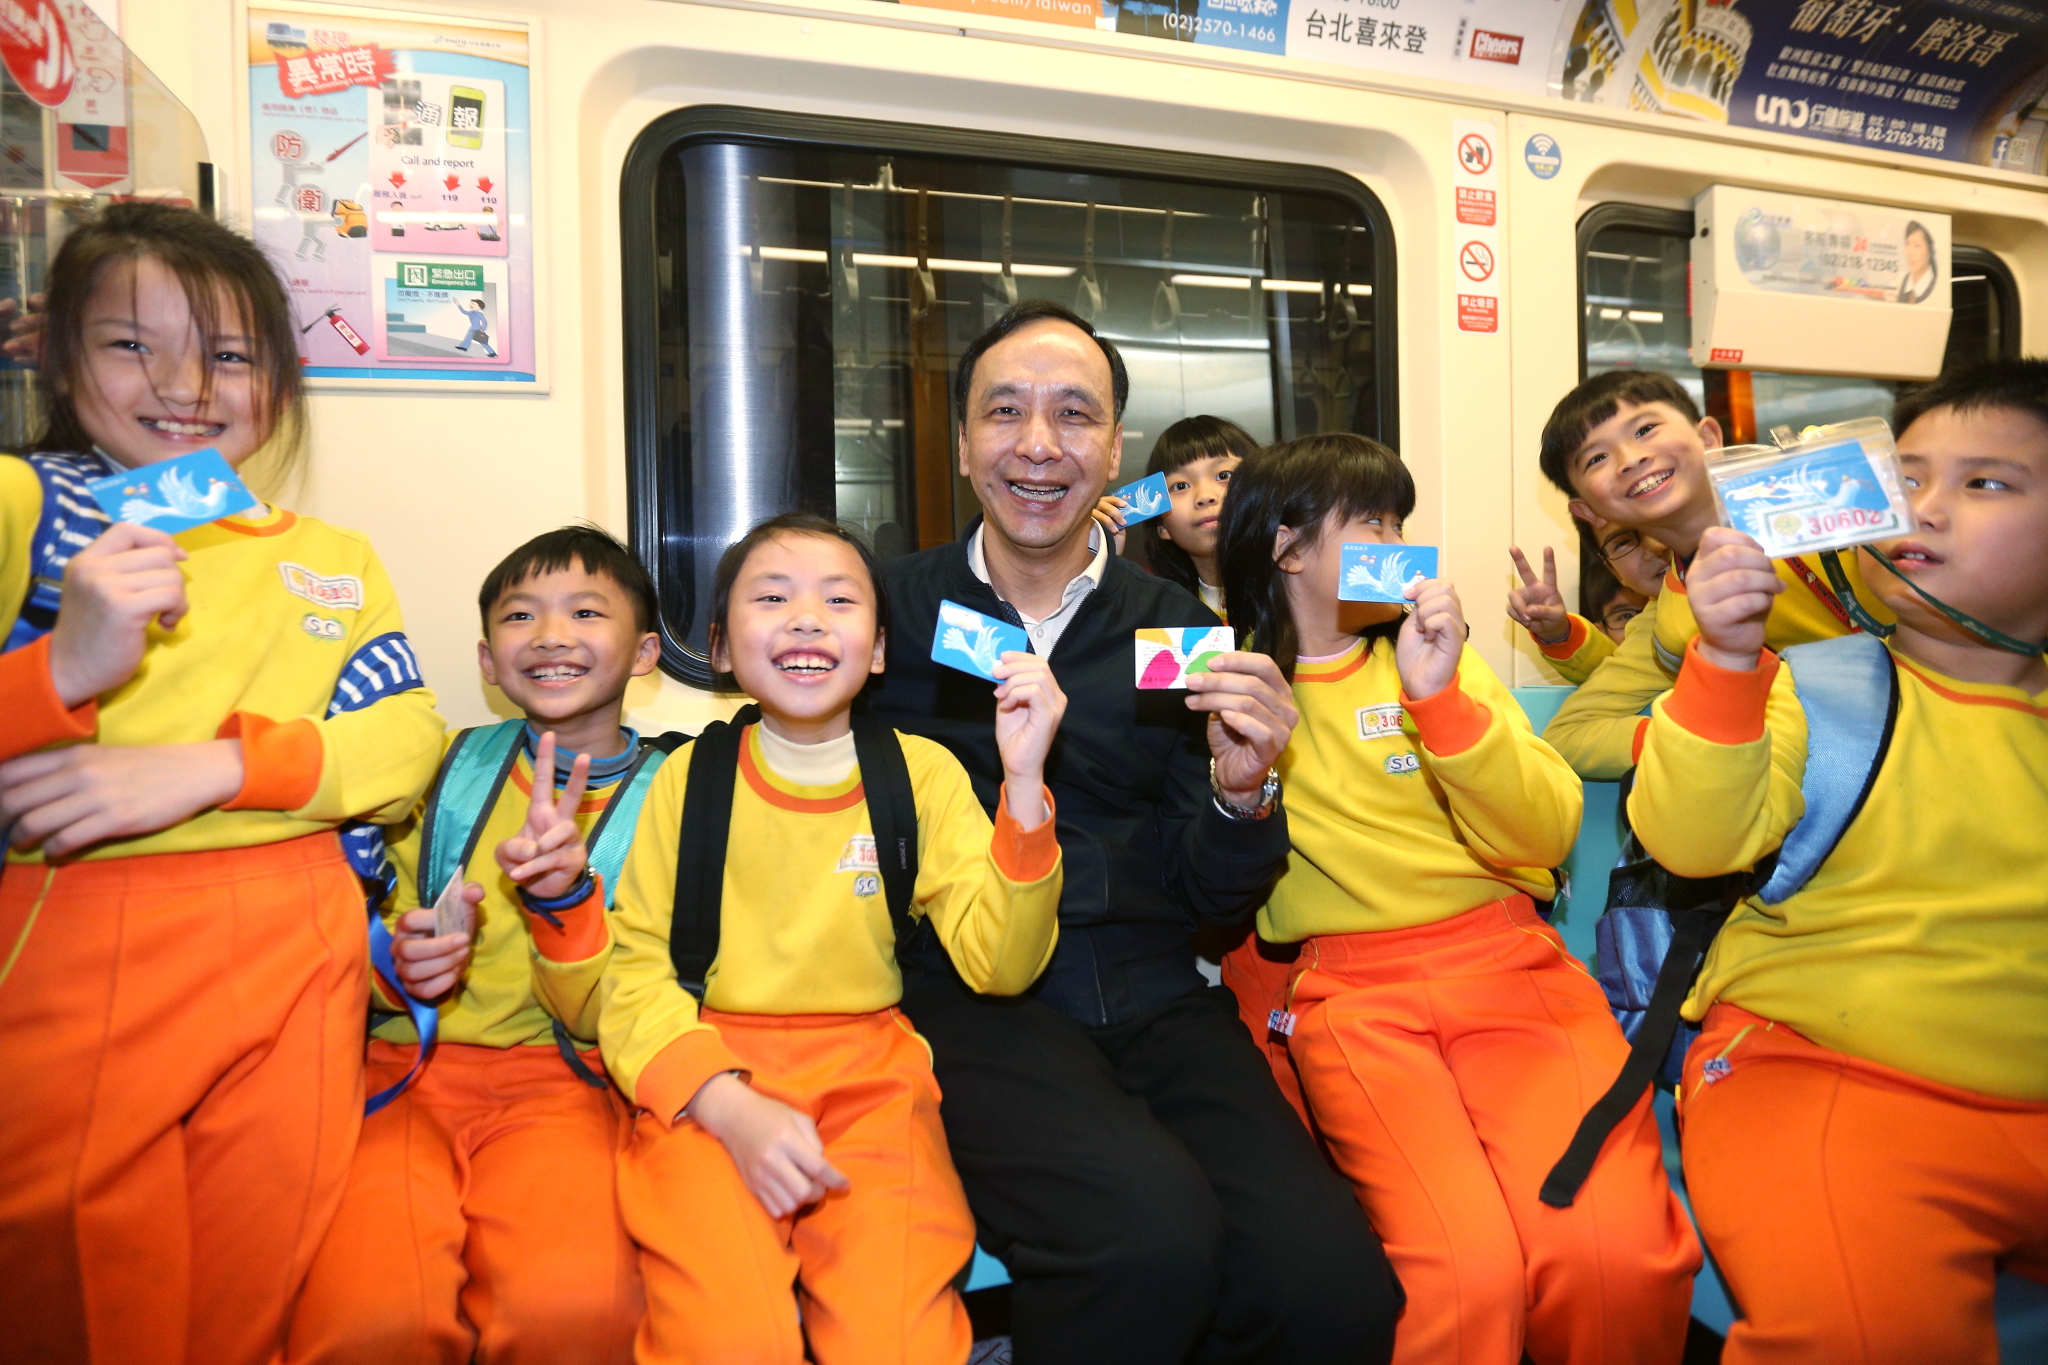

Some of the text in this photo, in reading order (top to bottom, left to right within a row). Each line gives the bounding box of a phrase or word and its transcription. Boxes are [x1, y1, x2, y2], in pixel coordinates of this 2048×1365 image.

[1162, 12, 1276, 42] (02)2570-1466
[1306, 9, 1427, 54] 台北喜來登
[1475, 32, 1519, 55] Cheers
[286, 47, 378, 88] 異常時
[276, 134, 301, 158] 防
[401, 155, 475, 169] Call and report
[297, 188, 322, 212] 衛
[441, 194, 458, 202] 119
[480, 196, 497, 204] 110
[1459, 188, 1494, 202] 禁止飲食
[431, 268, 475, 280] 緊急出口
[1808, 508, 1883, 536] 30602
[310, 619, 337, 635] SC
[1391, 756, 1415, 770] SC
[856, 879, 876, 892] SC
